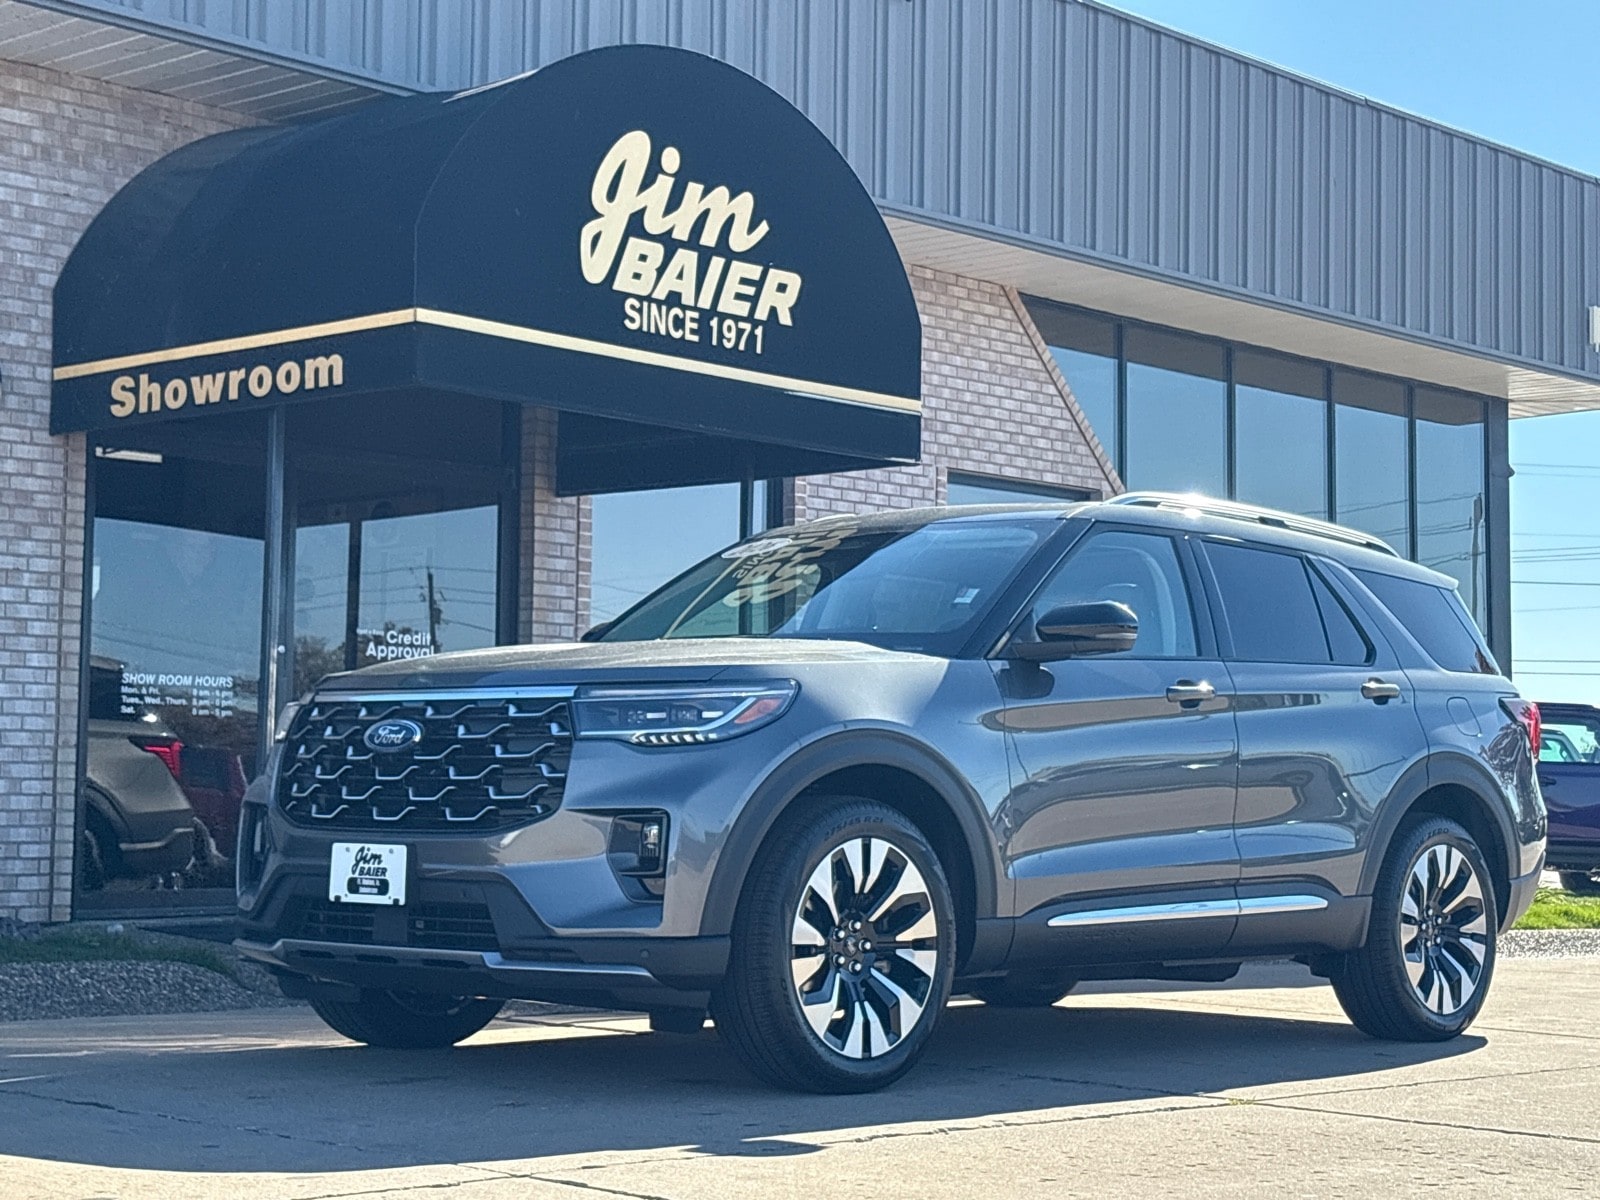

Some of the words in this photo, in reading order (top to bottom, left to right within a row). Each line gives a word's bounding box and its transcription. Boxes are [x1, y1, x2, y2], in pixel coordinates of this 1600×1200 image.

[580, 130, 770, 284] Jim
[612, 236, 802, 327] BAIER
[623, 297, 700, 343] SINCE
[709, 316, 764, 354] 1971
[110, 353, 344, 418] Showroom
[386, 630, 432, 646] Credit
[365, 641, 435, 661] Approval
[121, 672, 156, 685] SHOW
[158, 673, 192, 686] ROOM
[194, 675, 234, 688] HOURS
[120, 686, 139, 695] Mon.
[374, 725, 406, 744] Ford
[351, 845, 383, 875] Jim
[357, 866, 388, 877] BAIER
